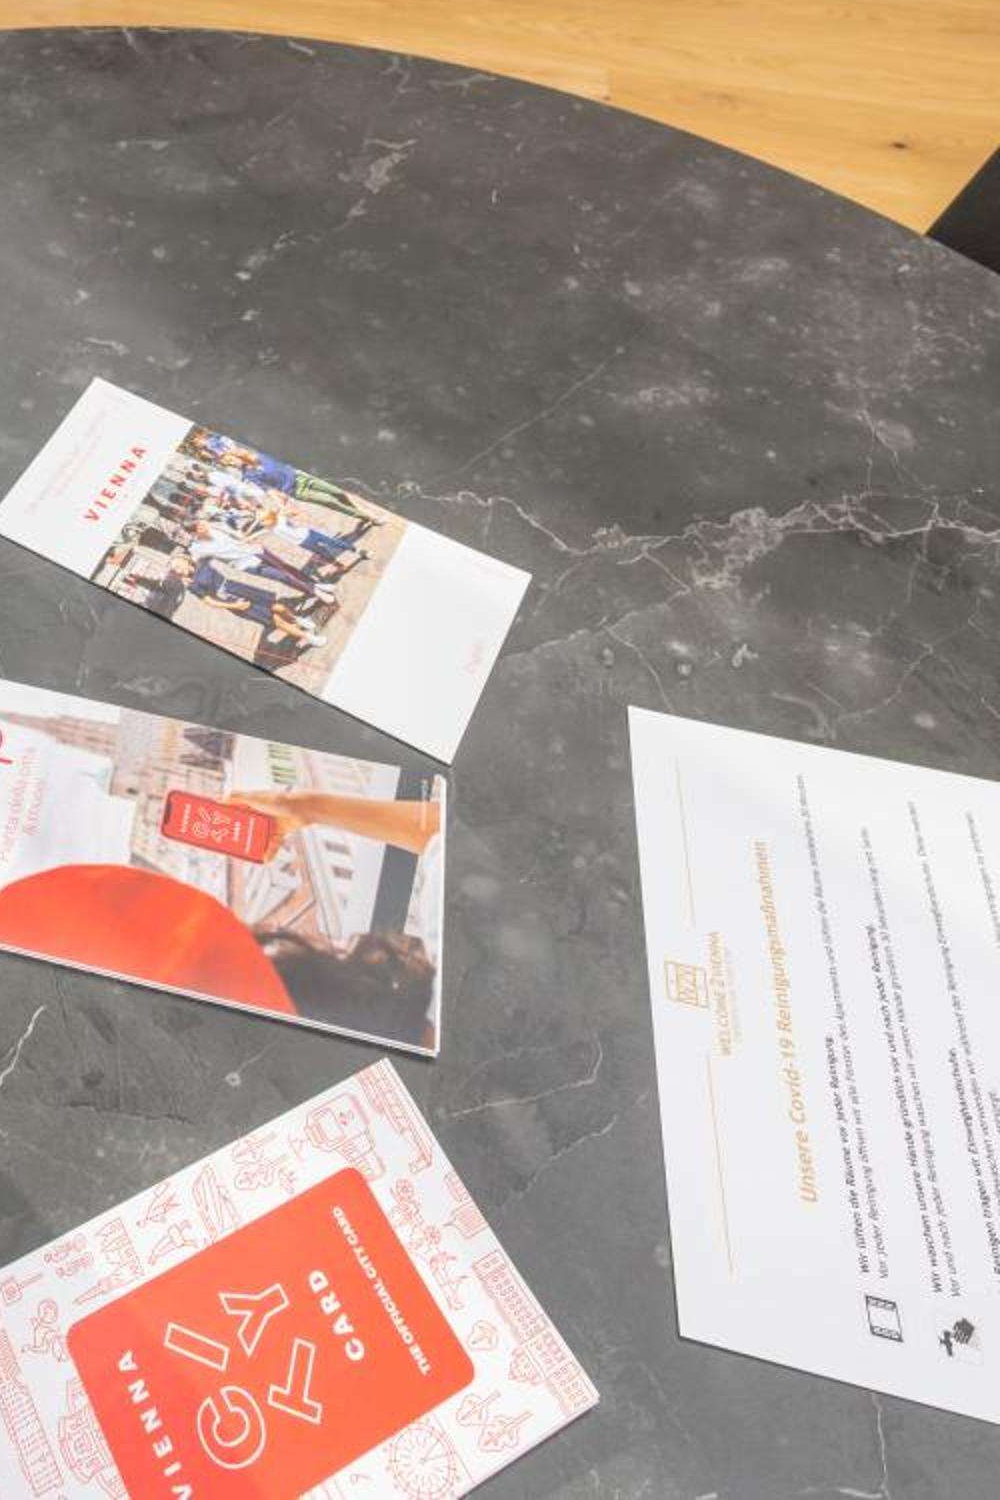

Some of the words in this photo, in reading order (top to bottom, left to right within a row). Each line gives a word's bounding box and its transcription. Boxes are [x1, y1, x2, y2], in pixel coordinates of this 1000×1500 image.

[83, 446, 147, 520] VIENNA
[754, 840, 794, 1033] Reinigungsmaßnahmen
[874, 975, 889, 1003] jeder
[879, 1003, 893, 1029] nach
[885, 1031, 897, 1053] und
[891, 1055, 901, 1073] vor
[777, 1037, 806, 1124] Covid-19
[831, 1091, 847, 1123] jeder
[893, 1074, 913, 1129] gründlich
[838, 1125, 848, 1143] vor
[794, 1129, 817, 1203] Unsere
[840, 1145, 855, 1187] Räume
[847, 1188, 859, 1209] die
[861, 1164, 880, 1221] Reinigung
[912, 1169, 927, 1211] unsere
[930, 1185, 946, 1217] jeder
[332, 1206, 358, 1246] CARD
[870, 1224, 886, 1256] jeder
[918, 1213, 937, 1267] waschen
[937, 1218, 950, 1249] nach
[354, 1246, 377, 1280] CITY
[857, 1252, 869, 1273] Wir
[876, 1258, 888, 1279] Vor
[943, 1250, 955, 1273] und
[929, 1269, 942, 1294] Wir
[948, 1276, 960, 1298] Vor
[309, 1269, 366, 1361] CARD
[374, 1278, 414, 1345] OFFICIAL
[408, 1343, 431, 1376] THE
[118, 1349, 193, 1500] VIENNA
